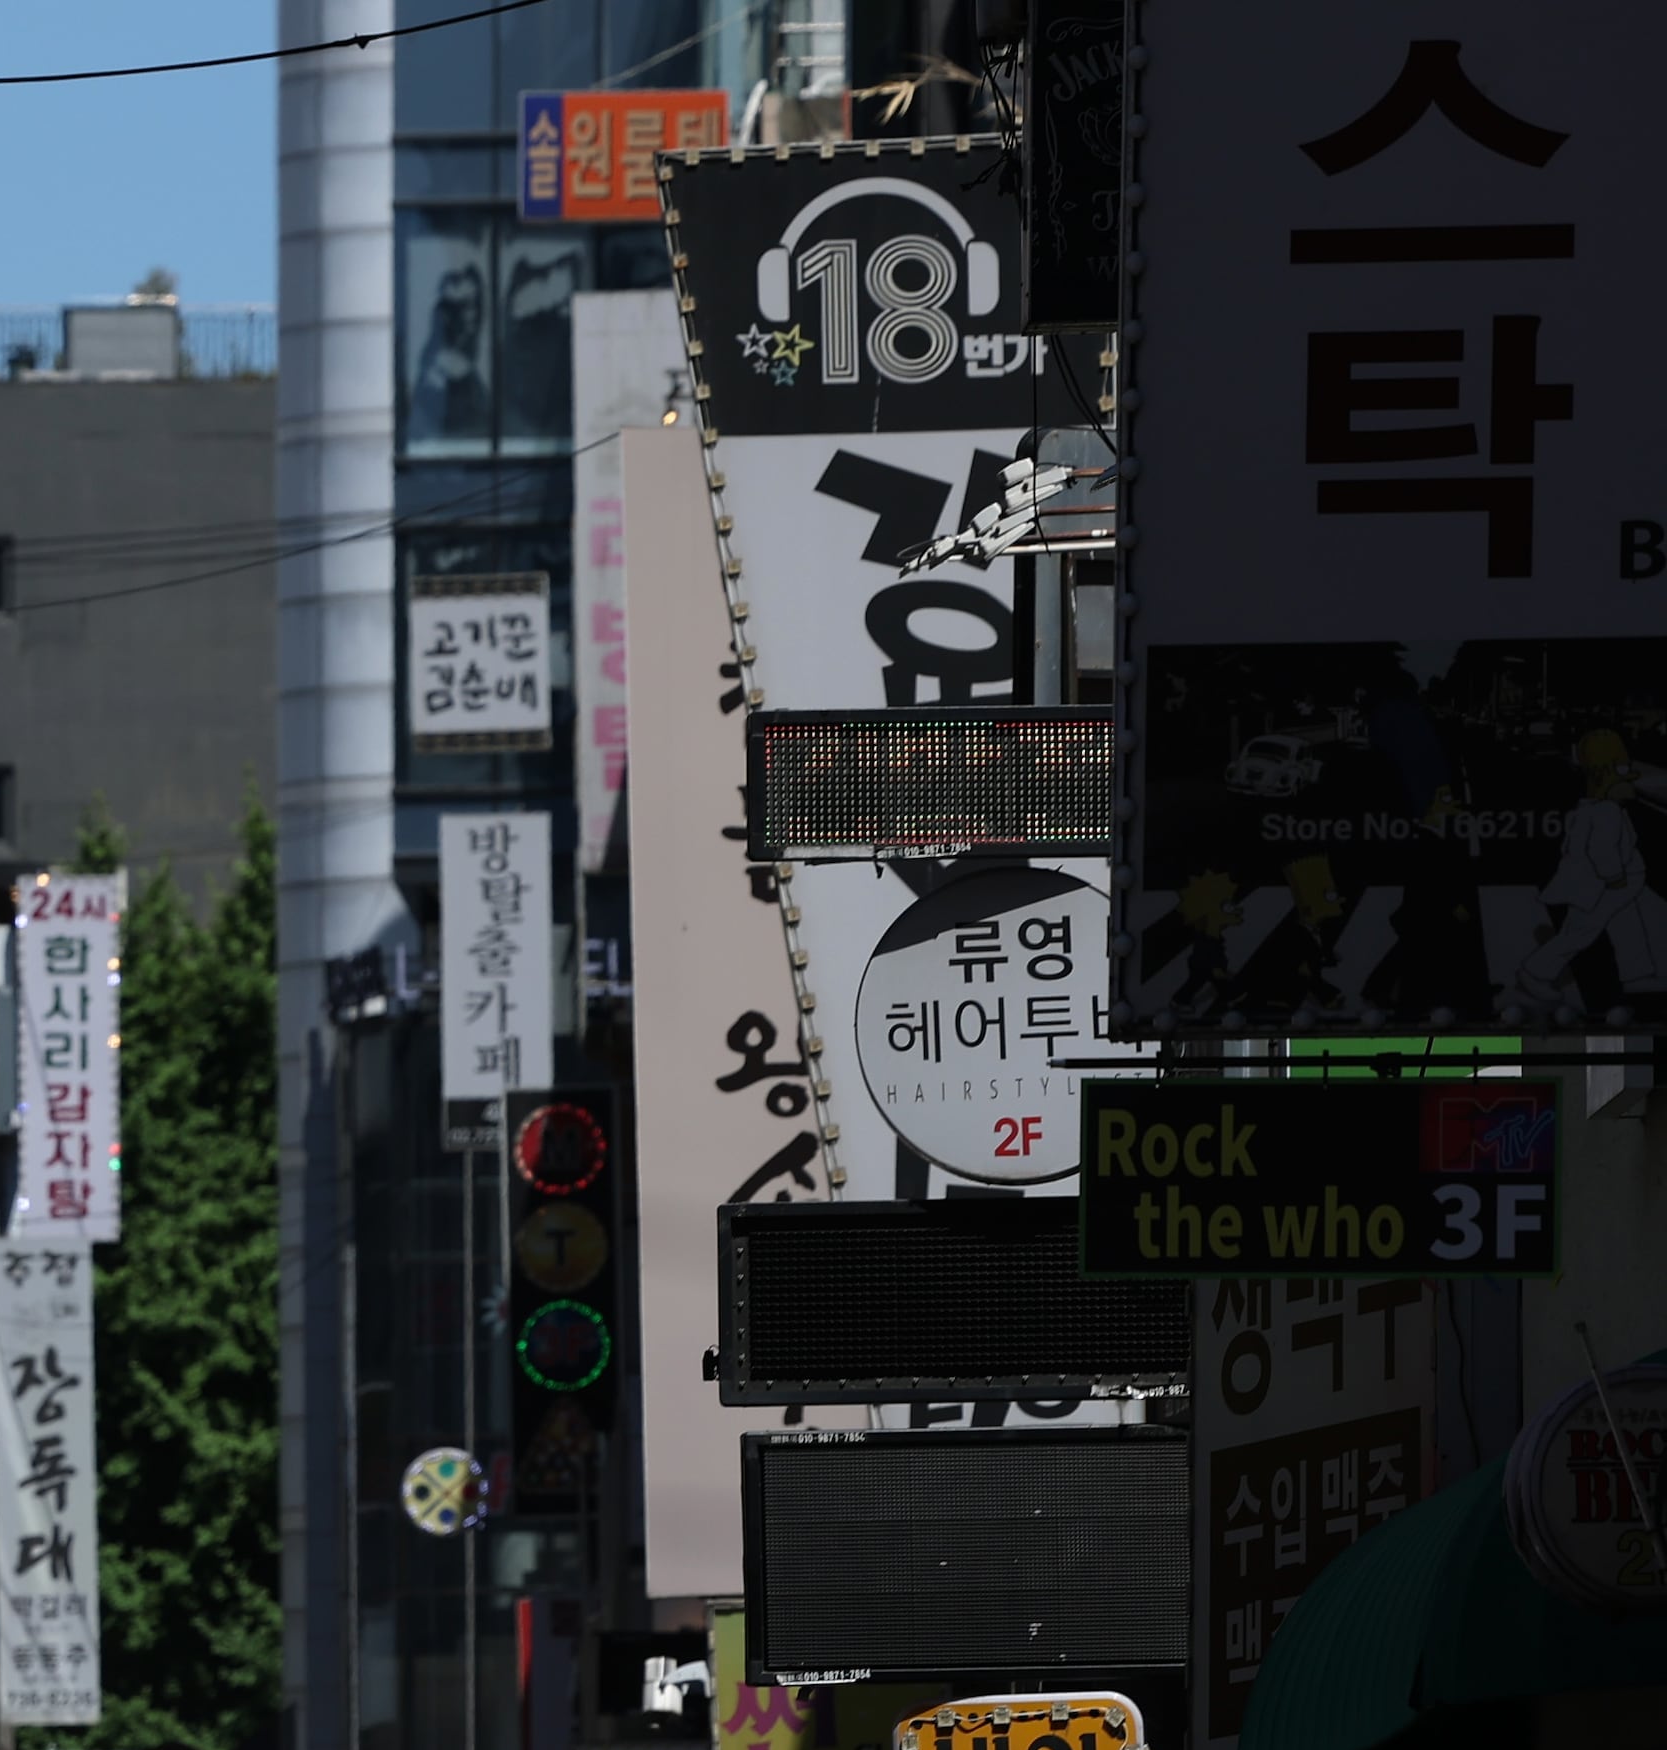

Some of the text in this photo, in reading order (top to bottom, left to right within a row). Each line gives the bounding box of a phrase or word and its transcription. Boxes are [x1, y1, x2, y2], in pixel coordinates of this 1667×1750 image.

[528, 109, 563, 199] 솔
[797, 235, 1049, 385] 18번가
[1290, 39, 1575, 578] 스탁
[424, 613, 537, 660] 고기꾼
[1260, 811, 1354, 842] Store
[31, 889, 108, 922] 24시
[468, 823, 531, 1091] 방탈출카페
[948, 915, 1075, 984] 류영
[43, 935, 94, 1220] 한사리감자탕
[886, 1072, 1144, 1104] HAIRSTYL
[994, 1117, 1043, 1157] 2F
[1097, 1104, 1260, 1179] Rock
[1438, 1097, 1556, 1173] MTV
[1133, 1184, 1548, 1261] the who 3F
[11, 1347, 81, 1582] 장독대
[1617, 1529, 1667, 1586] 2
[1227, 1600, 1281, 1686] 맥
